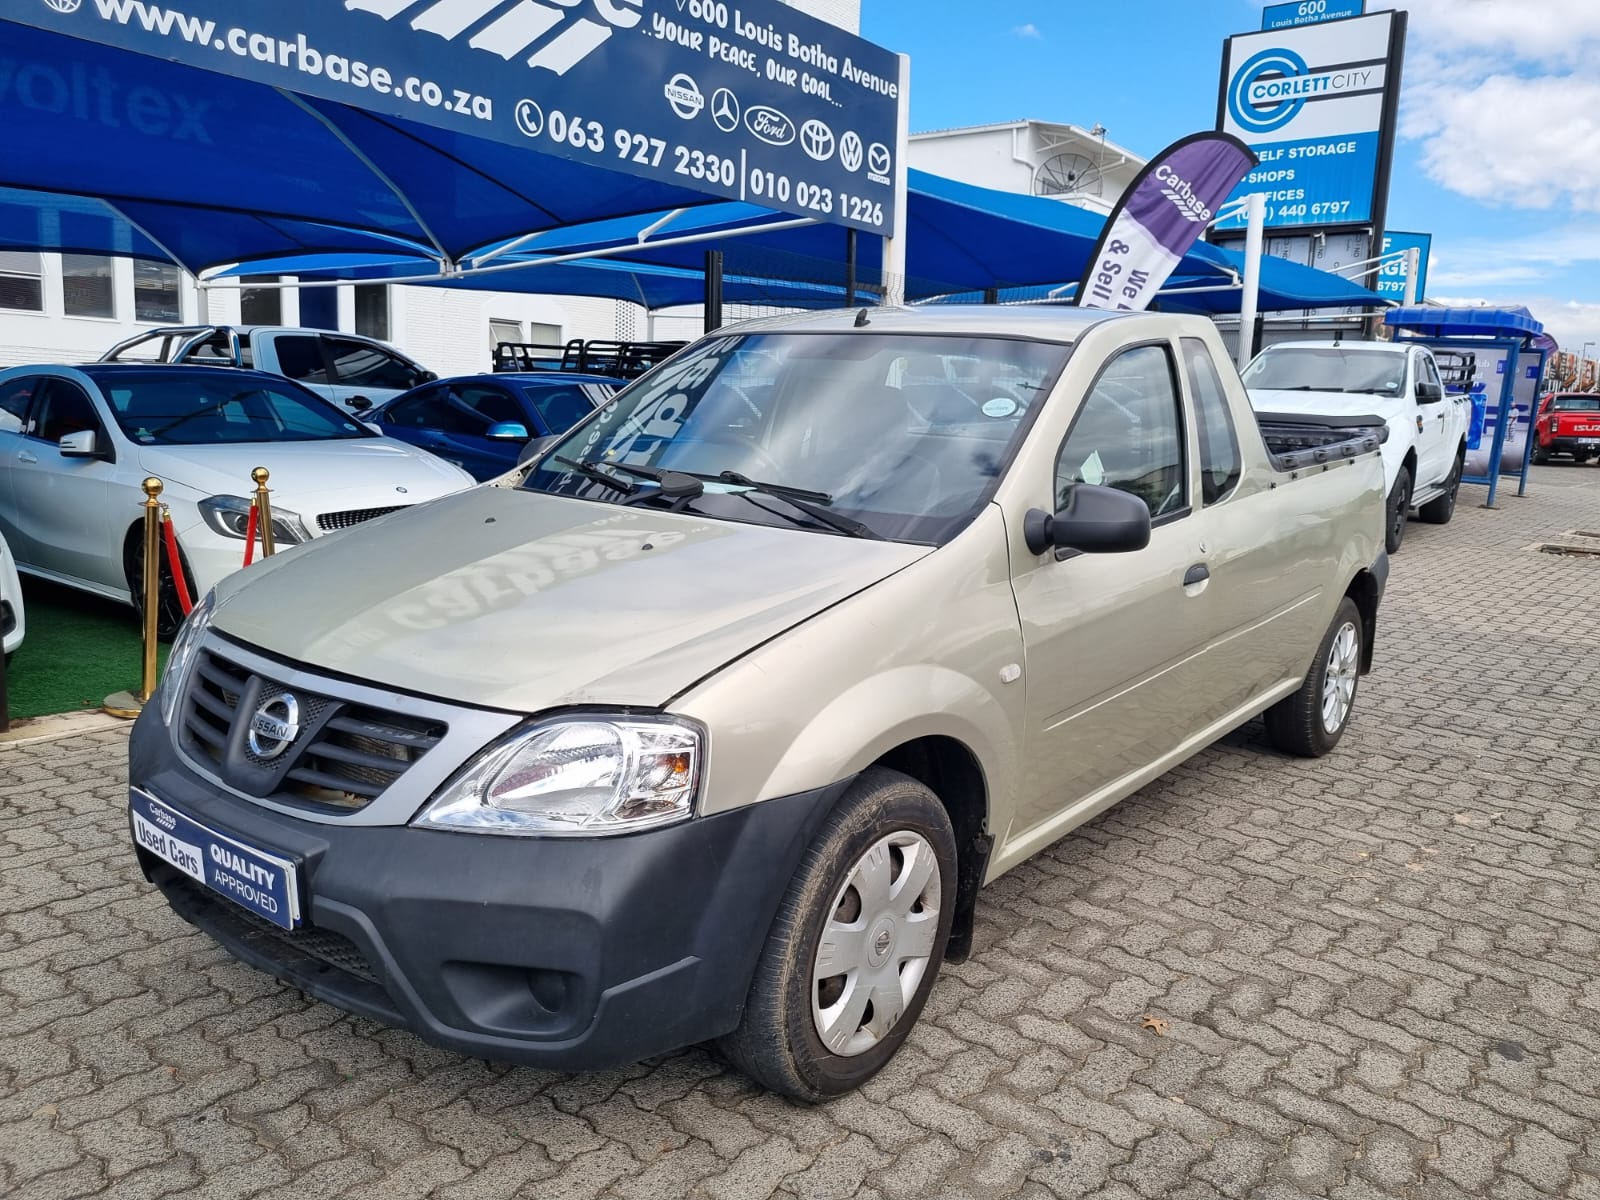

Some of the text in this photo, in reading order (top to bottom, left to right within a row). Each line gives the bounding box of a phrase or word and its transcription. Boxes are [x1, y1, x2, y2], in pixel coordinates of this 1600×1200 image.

[1271, 9, 1352, 28] Louis Botha Avenue
[1298, 0, 1326, 16] 600
[95, 0, 493, 121] www.carbase.co.za
[689, 0, 728, 28] 600
[735, 10, 782, 52] Louis
[788, 29, 838, 75] Botha
[842, 57, 898, 100] Avenue
[766, 59, 798, 88] OUR
[667, 87, 702, 106] NISSAN
[753, 111, 787, 140] Ford
[549, 110, 735, 187] 063 927 2330
[1288, 142, 1357, 158] STORAGE
[1248, 170, 1295, 183] SHOPS
[750, 168, 883, 226] 010 023 1226
[1155, 164, 1212, 222] Carbase
[1278, 205, 1307, 217] 440
[1311, 201, 1350, 215] 6797
[1108, 239, 1130, 255] &
[1092, 260, 1122, 302] Sell
[1122, 269, 1149, 299] We
[1378, 281, 1406, 291] 6797
[149, 803, 177, 825] Carbase
[138, 820, 199, 875] Used Cars
[210, 843, 276, 890] QUALITY
[214, 869, 278, 913] APPROVED
